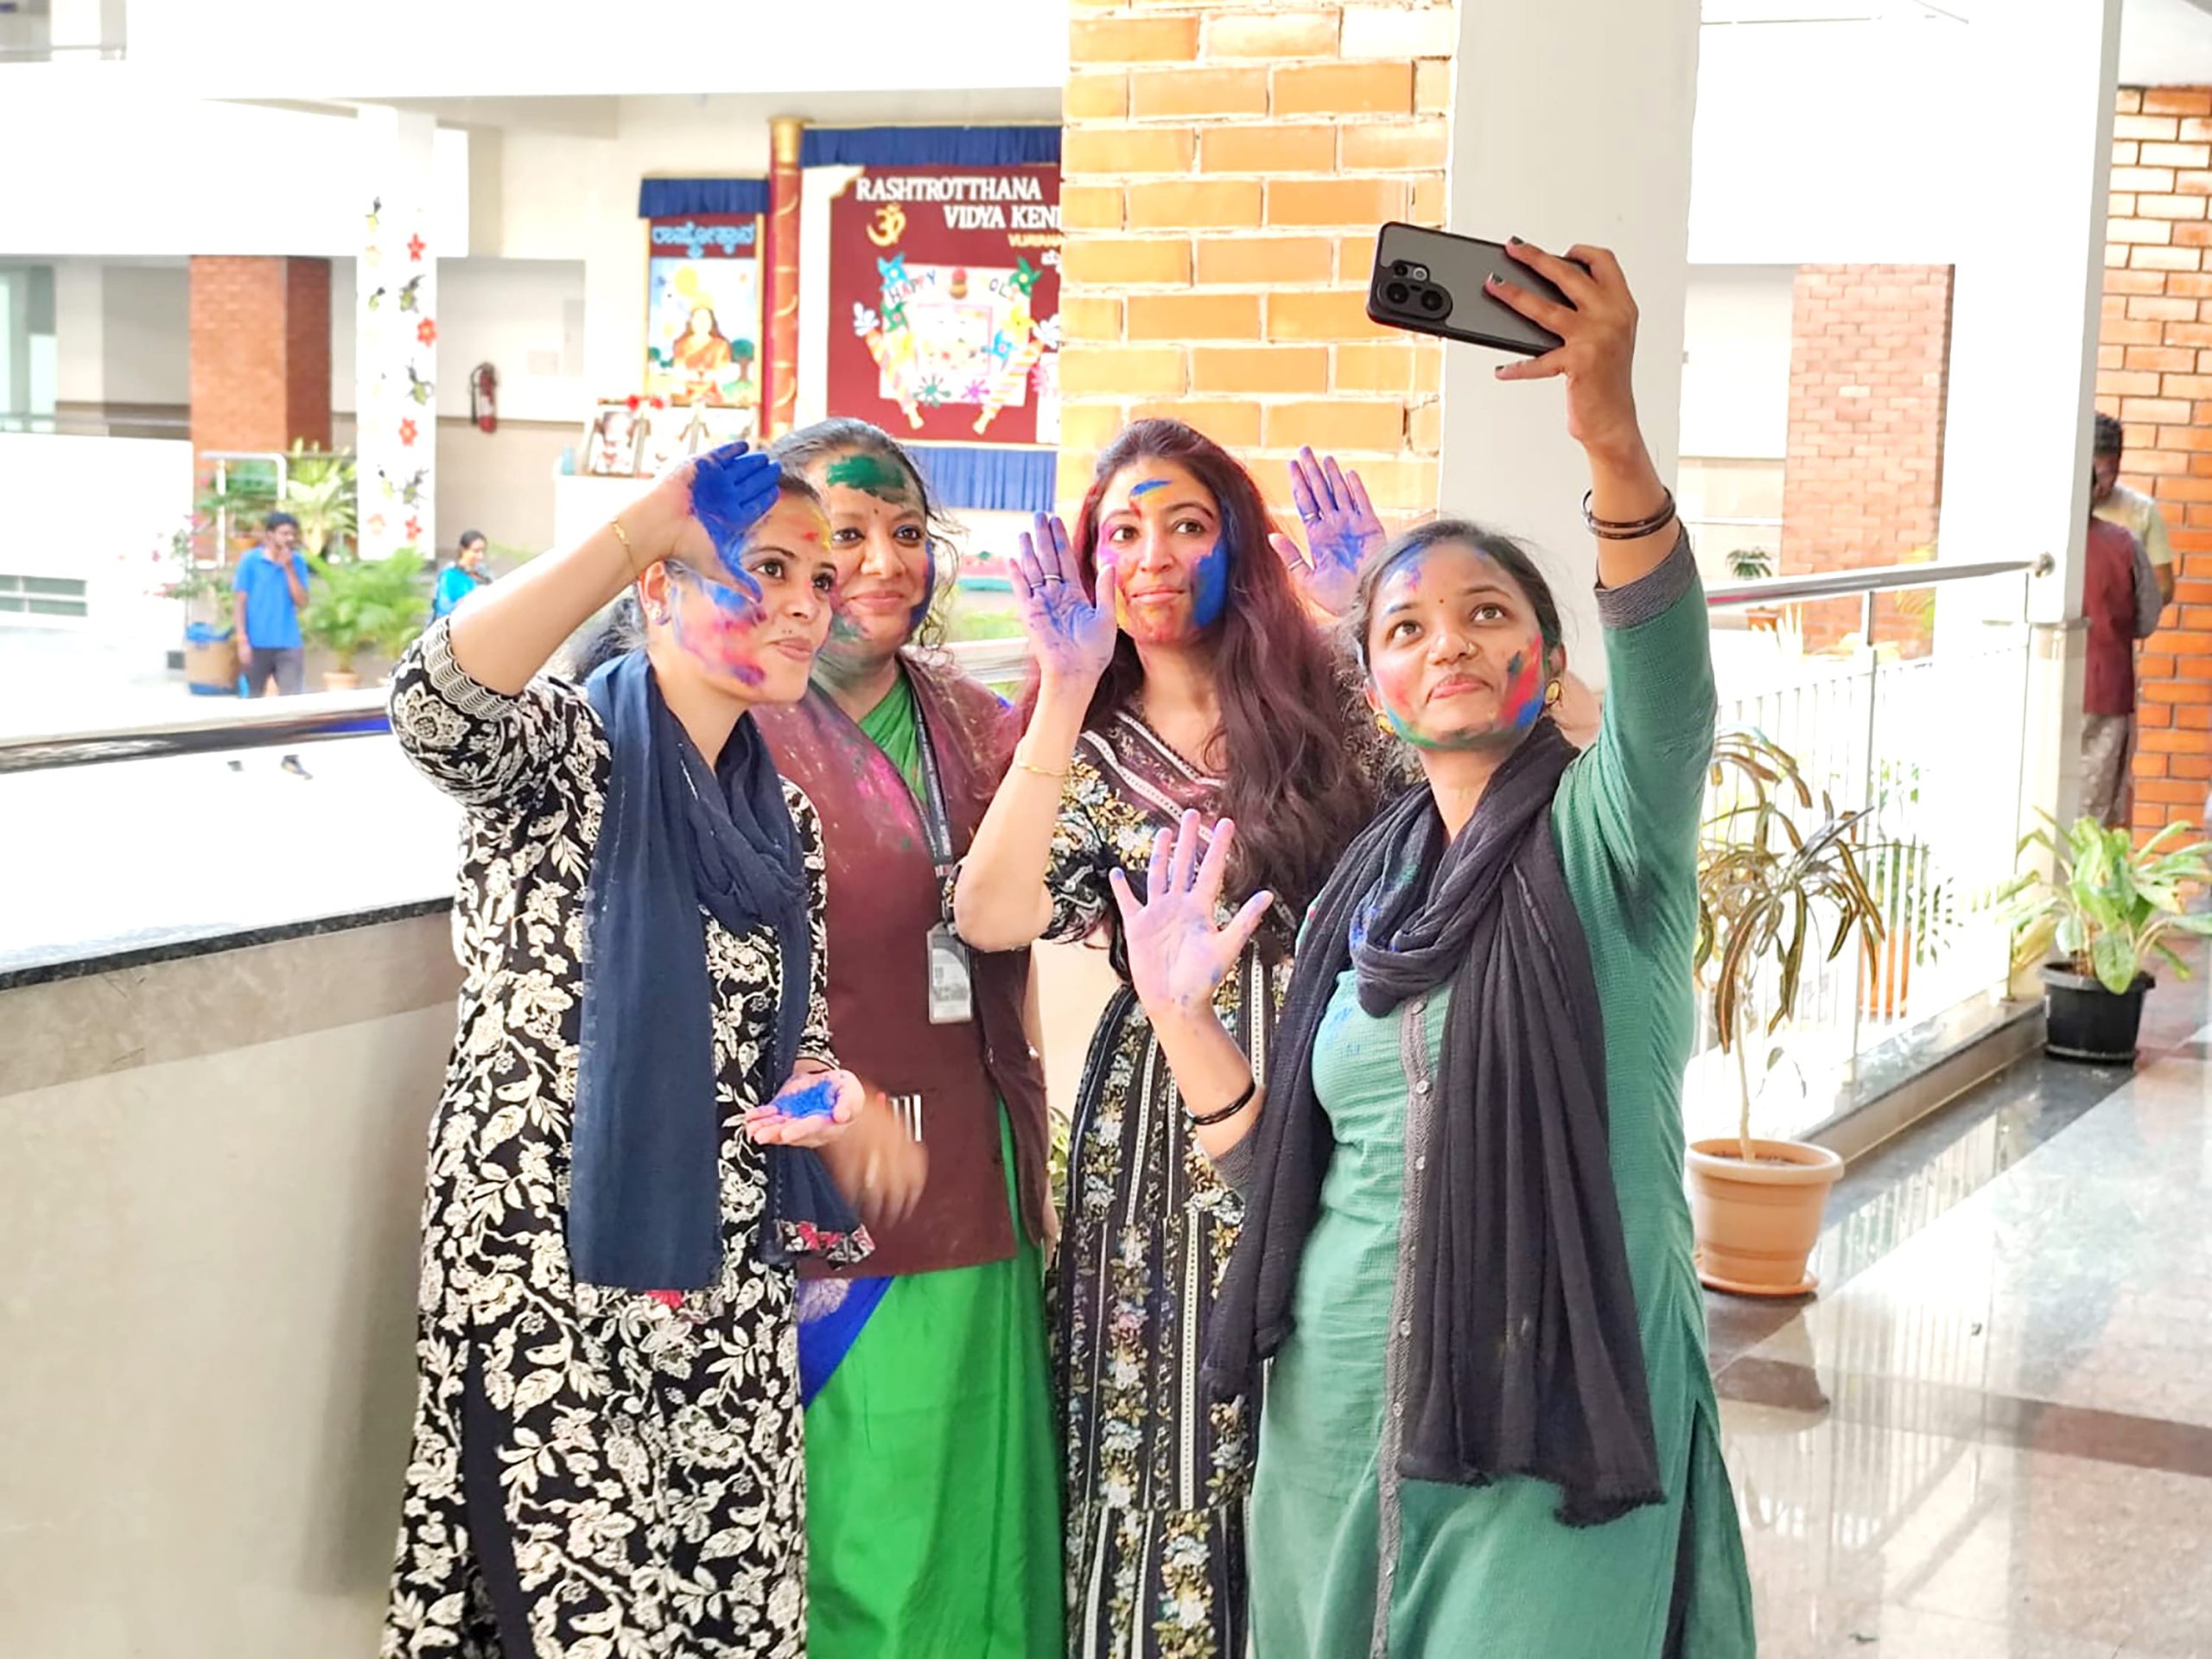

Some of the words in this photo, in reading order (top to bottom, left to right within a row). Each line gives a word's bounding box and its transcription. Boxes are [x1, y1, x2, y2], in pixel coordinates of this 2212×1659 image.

[856, 177, 1042, 201] RASHTROTTHANA
[944, 205, 1006, 229] VIDYA
[888, 269, 936, 303] HAPPY
